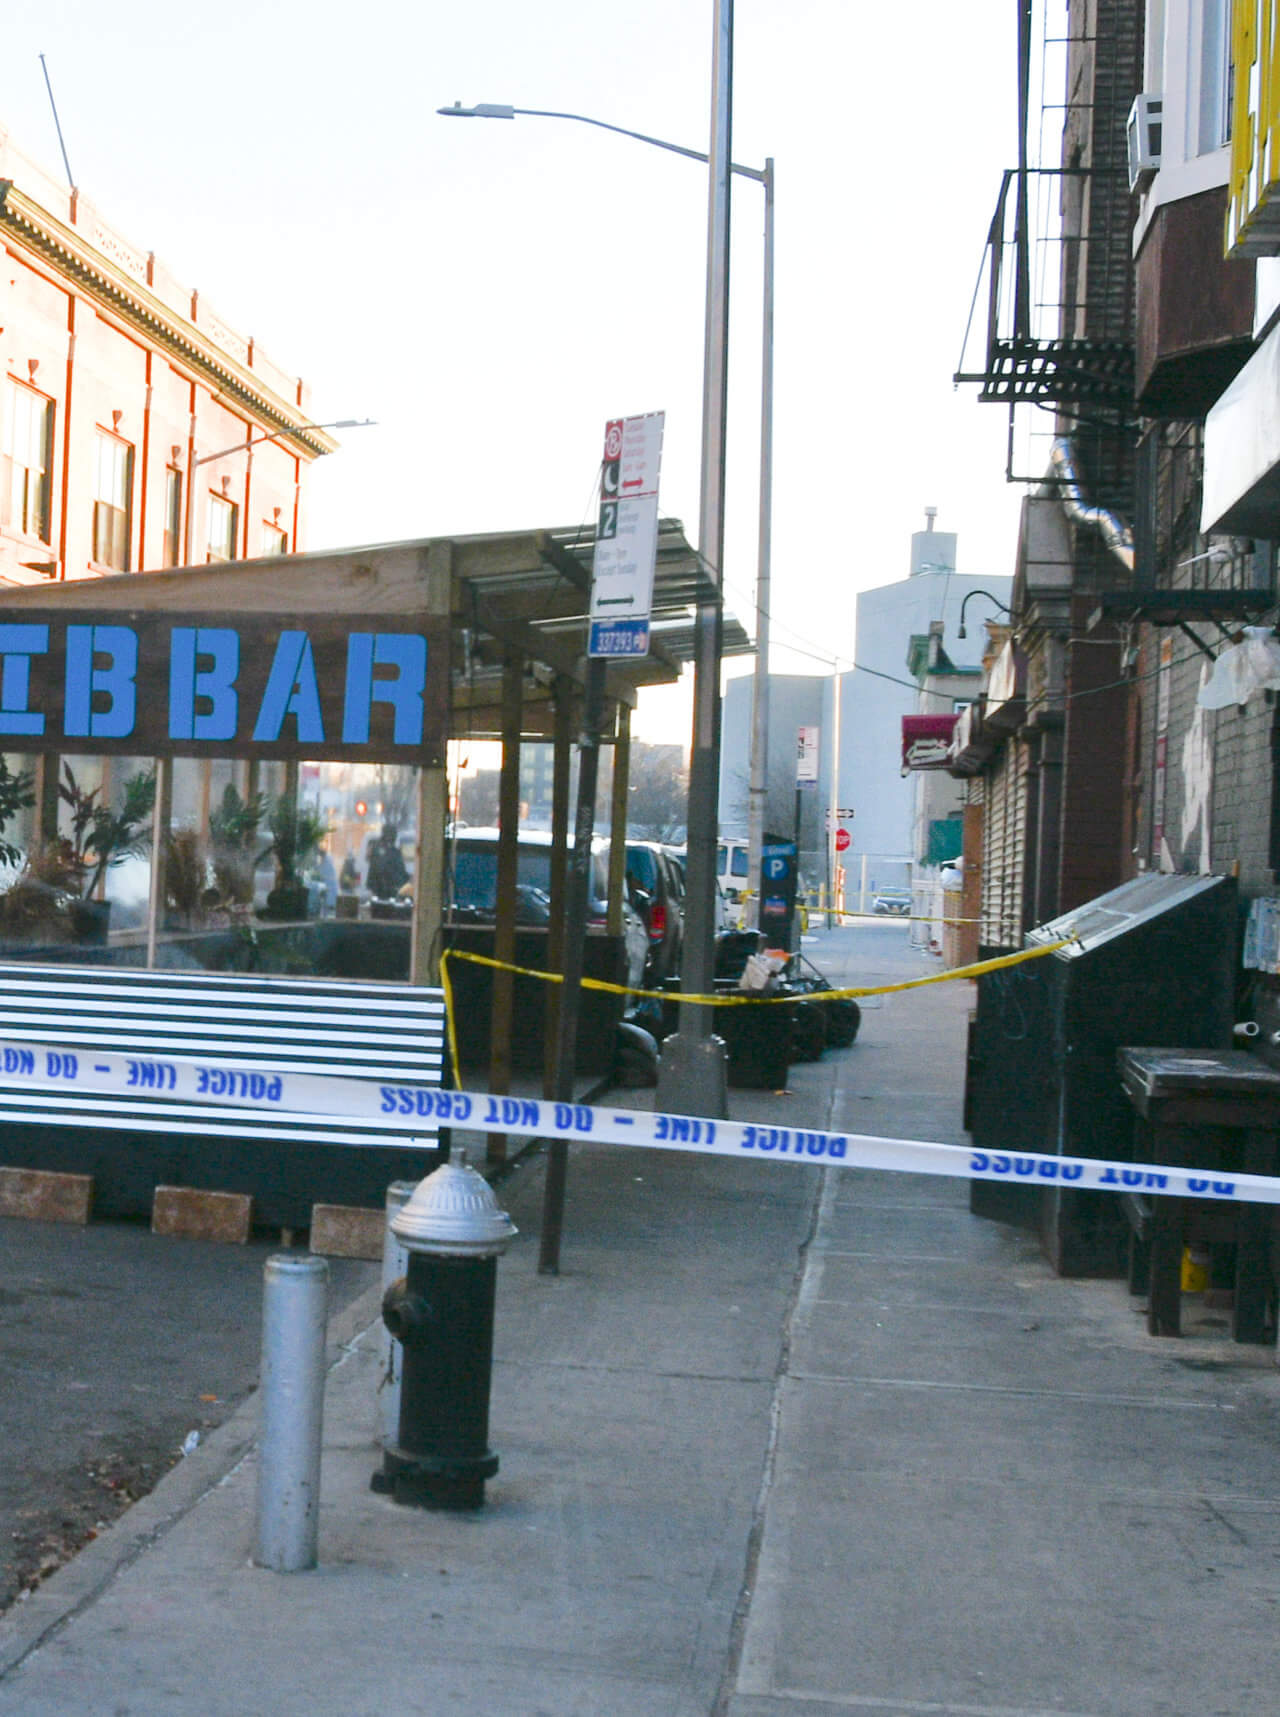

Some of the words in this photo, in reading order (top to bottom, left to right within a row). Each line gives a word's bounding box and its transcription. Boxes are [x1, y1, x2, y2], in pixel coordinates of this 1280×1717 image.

[166, 626, 428, 746] BAR
[770, 859, 784, 878] P
[46, 1051, 79, 1079] DO
[126, 1059, 177, 1091] LINE
[195, 1066, 283, 1102] POLICE
[379, 1085, 473, 1121] CROSS
[483, 1096, 541, 1127] NOT
[554, 1103, 594, 1133] DO
[654, 1115, 717, 1145] LINE
[740, 1126, 848, 1158] POLICE
